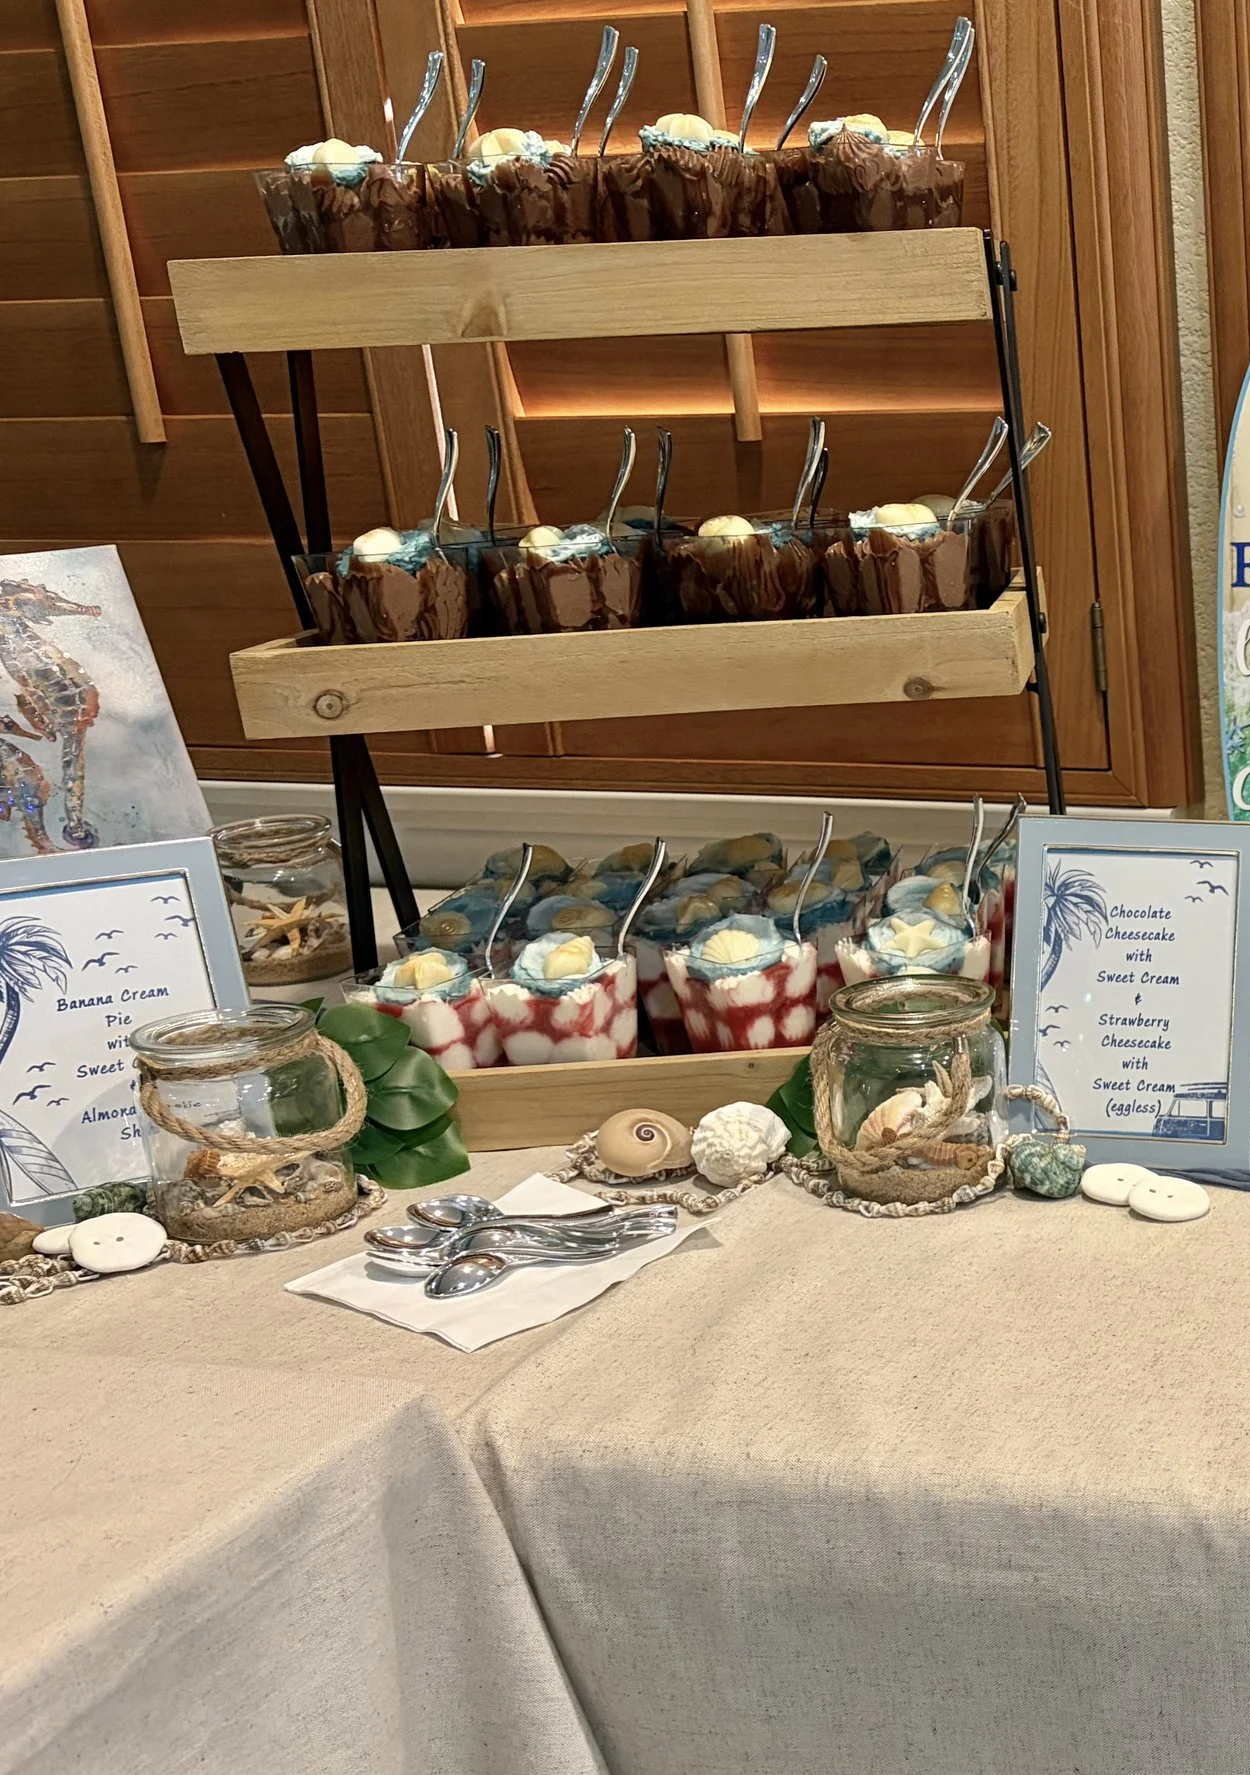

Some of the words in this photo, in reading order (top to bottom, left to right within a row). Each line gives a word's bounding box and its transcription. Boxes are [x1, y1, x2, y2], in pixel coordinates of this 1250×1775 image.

[1110, 904, 1172, 920] Chocolate
[1105, 926, 1176, 942] Cheesecake
[1125, 947, 1152, 963] with
[1096, 970, 1134, 984] Sweet
[1140, 971, 1180, 986] Cream
[57, 994, 114, 1012] Banana
[120, 986, 169, 1003] Cream
[104, 1011, 133, 1028] Pie
[1098, 1013, 1170, 1031] Strawberry
[107, 1034, 130, 1050] wit
[1101, 1034, 1172, 1050] Cheesecake
[76, 1059, 125, 1079] Sweet
[1122, 1055, 1149, 1071] with
[1092, 1077, 1132, 1092] Sweet
[1136, 1079, 1177, 1094] Cream
[1105, 1097, 1163, 1119] (eggless)
